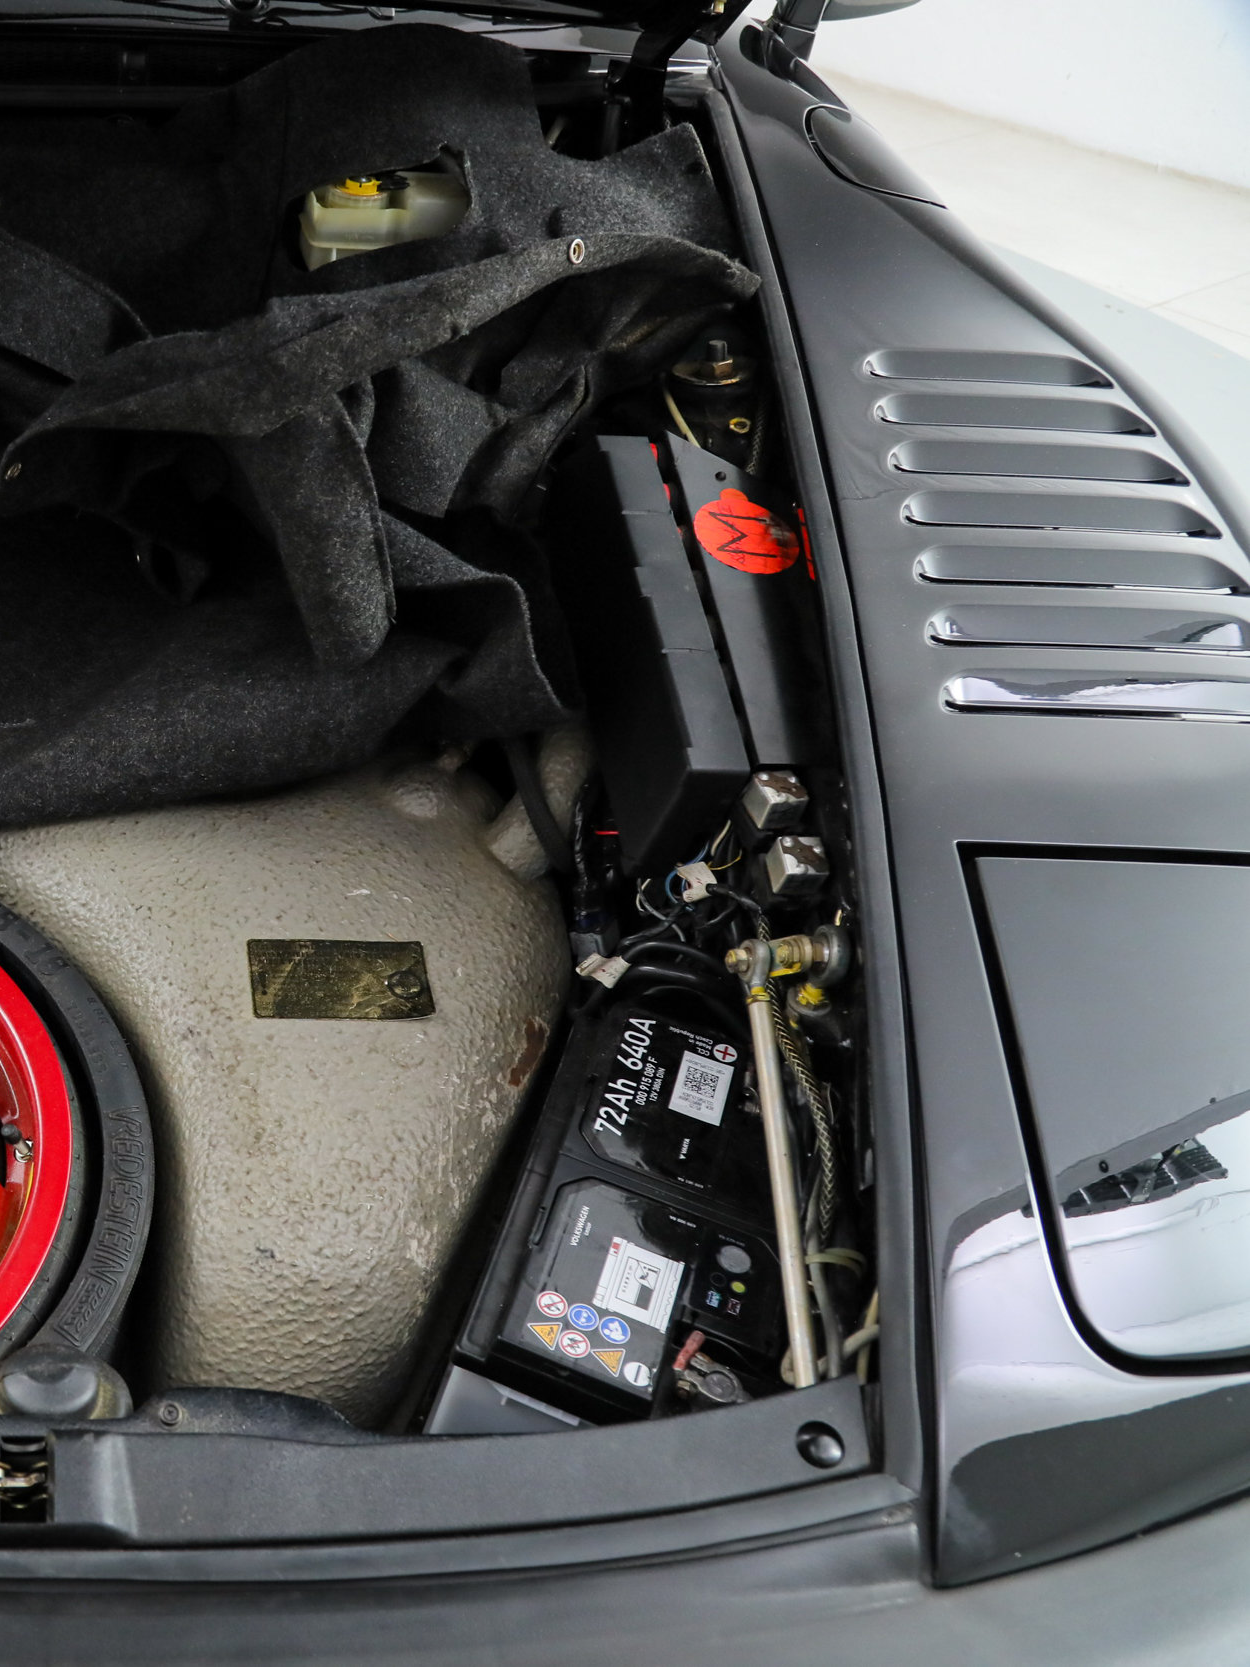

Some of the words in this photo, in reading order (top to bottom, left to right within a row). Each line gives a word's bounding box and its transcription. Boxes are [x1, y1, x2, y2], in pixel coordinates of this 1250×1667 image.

[647, 1055, 658, 1064] F
[593, 1078, 637, 1137] 72Ah
[616, 1018, 657, 1071] 640A
[643, 1062, 656, 1078] 089
[639, 1076, 653, 1091] 915
[634, 1090, 648, 1106] 000
[648, 1090, 659, 1102] 12V
[680, 1138, 691, 1155] VARTA
[89, 1106, 144, 1284] VREDESTEIN
[569, 1205, 590, 1246] VOLKSWAGEN
